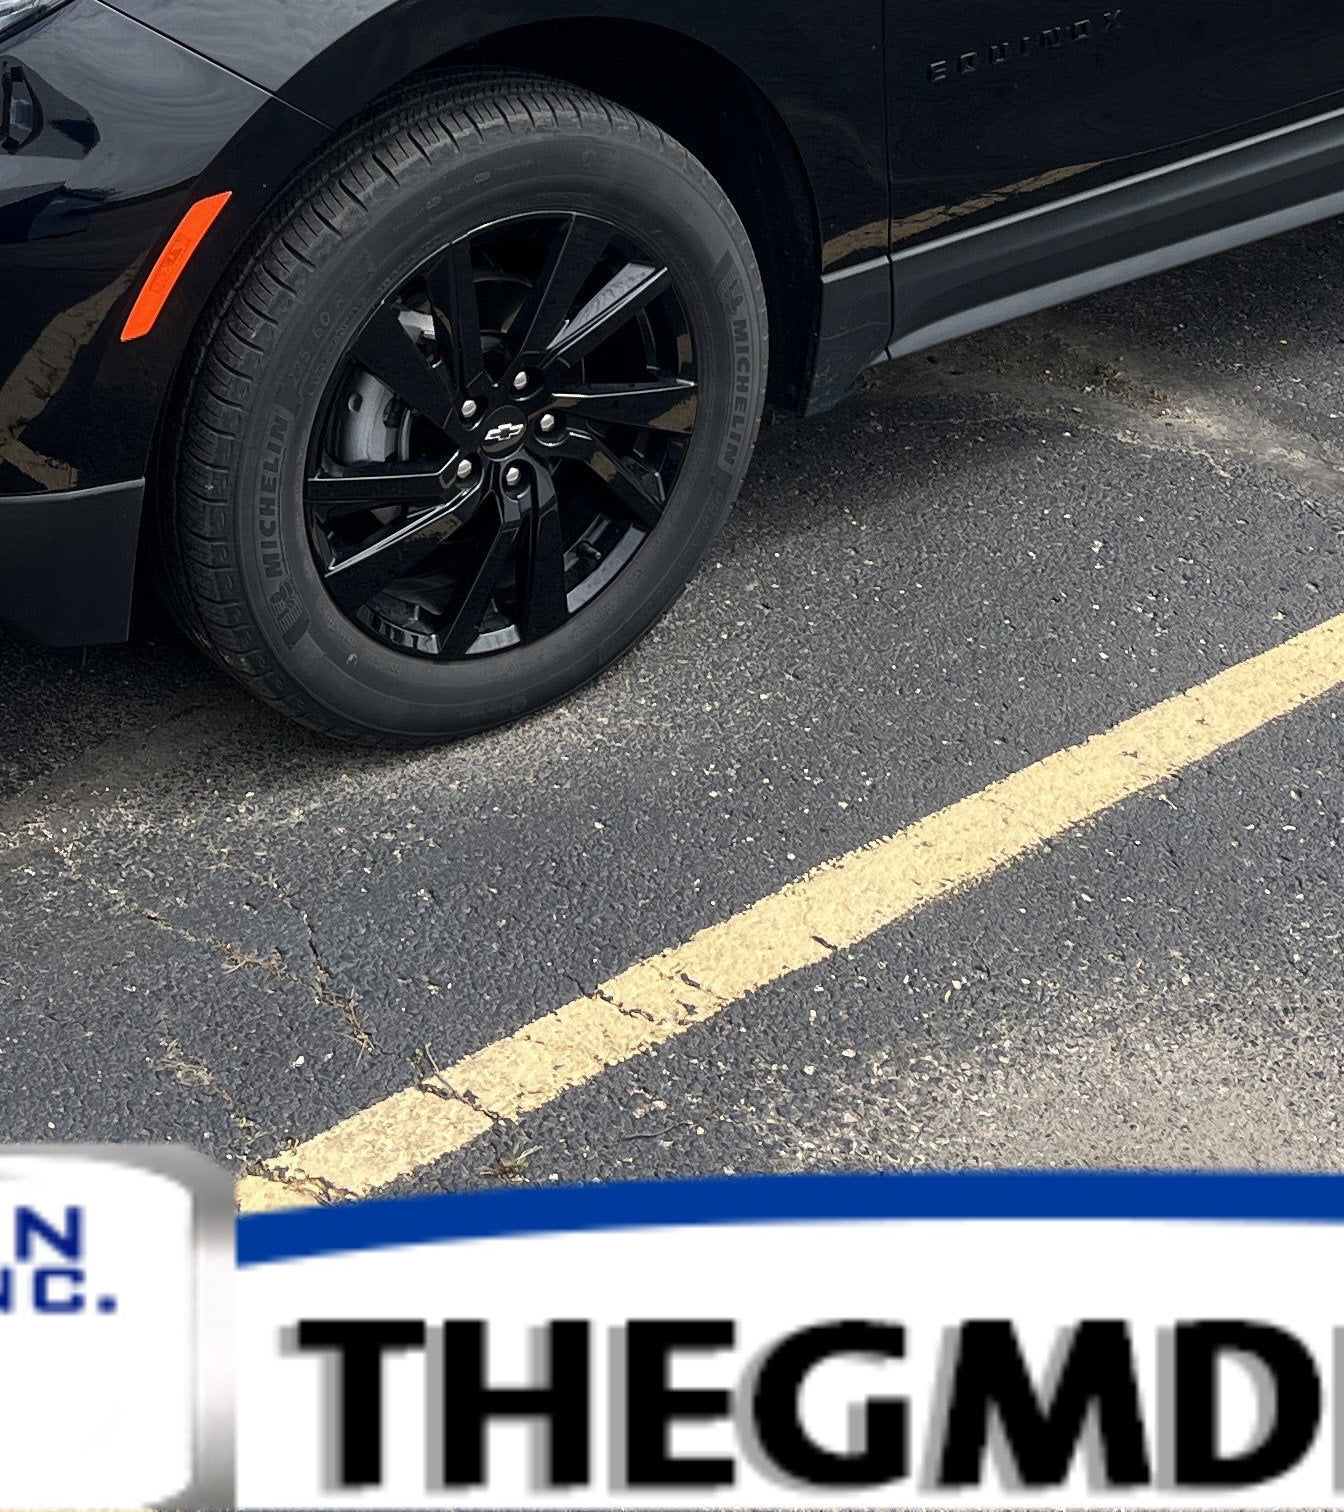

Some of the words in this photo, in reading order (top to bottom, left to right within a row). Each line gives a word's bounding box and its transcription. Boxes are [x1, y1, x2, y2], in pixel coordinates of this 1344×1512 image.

[927, 9, 1123, 84] EQUINOX
[722, 317, 752, 467] MICHELIN
[256, 413, 291, 581] MICHELIN
